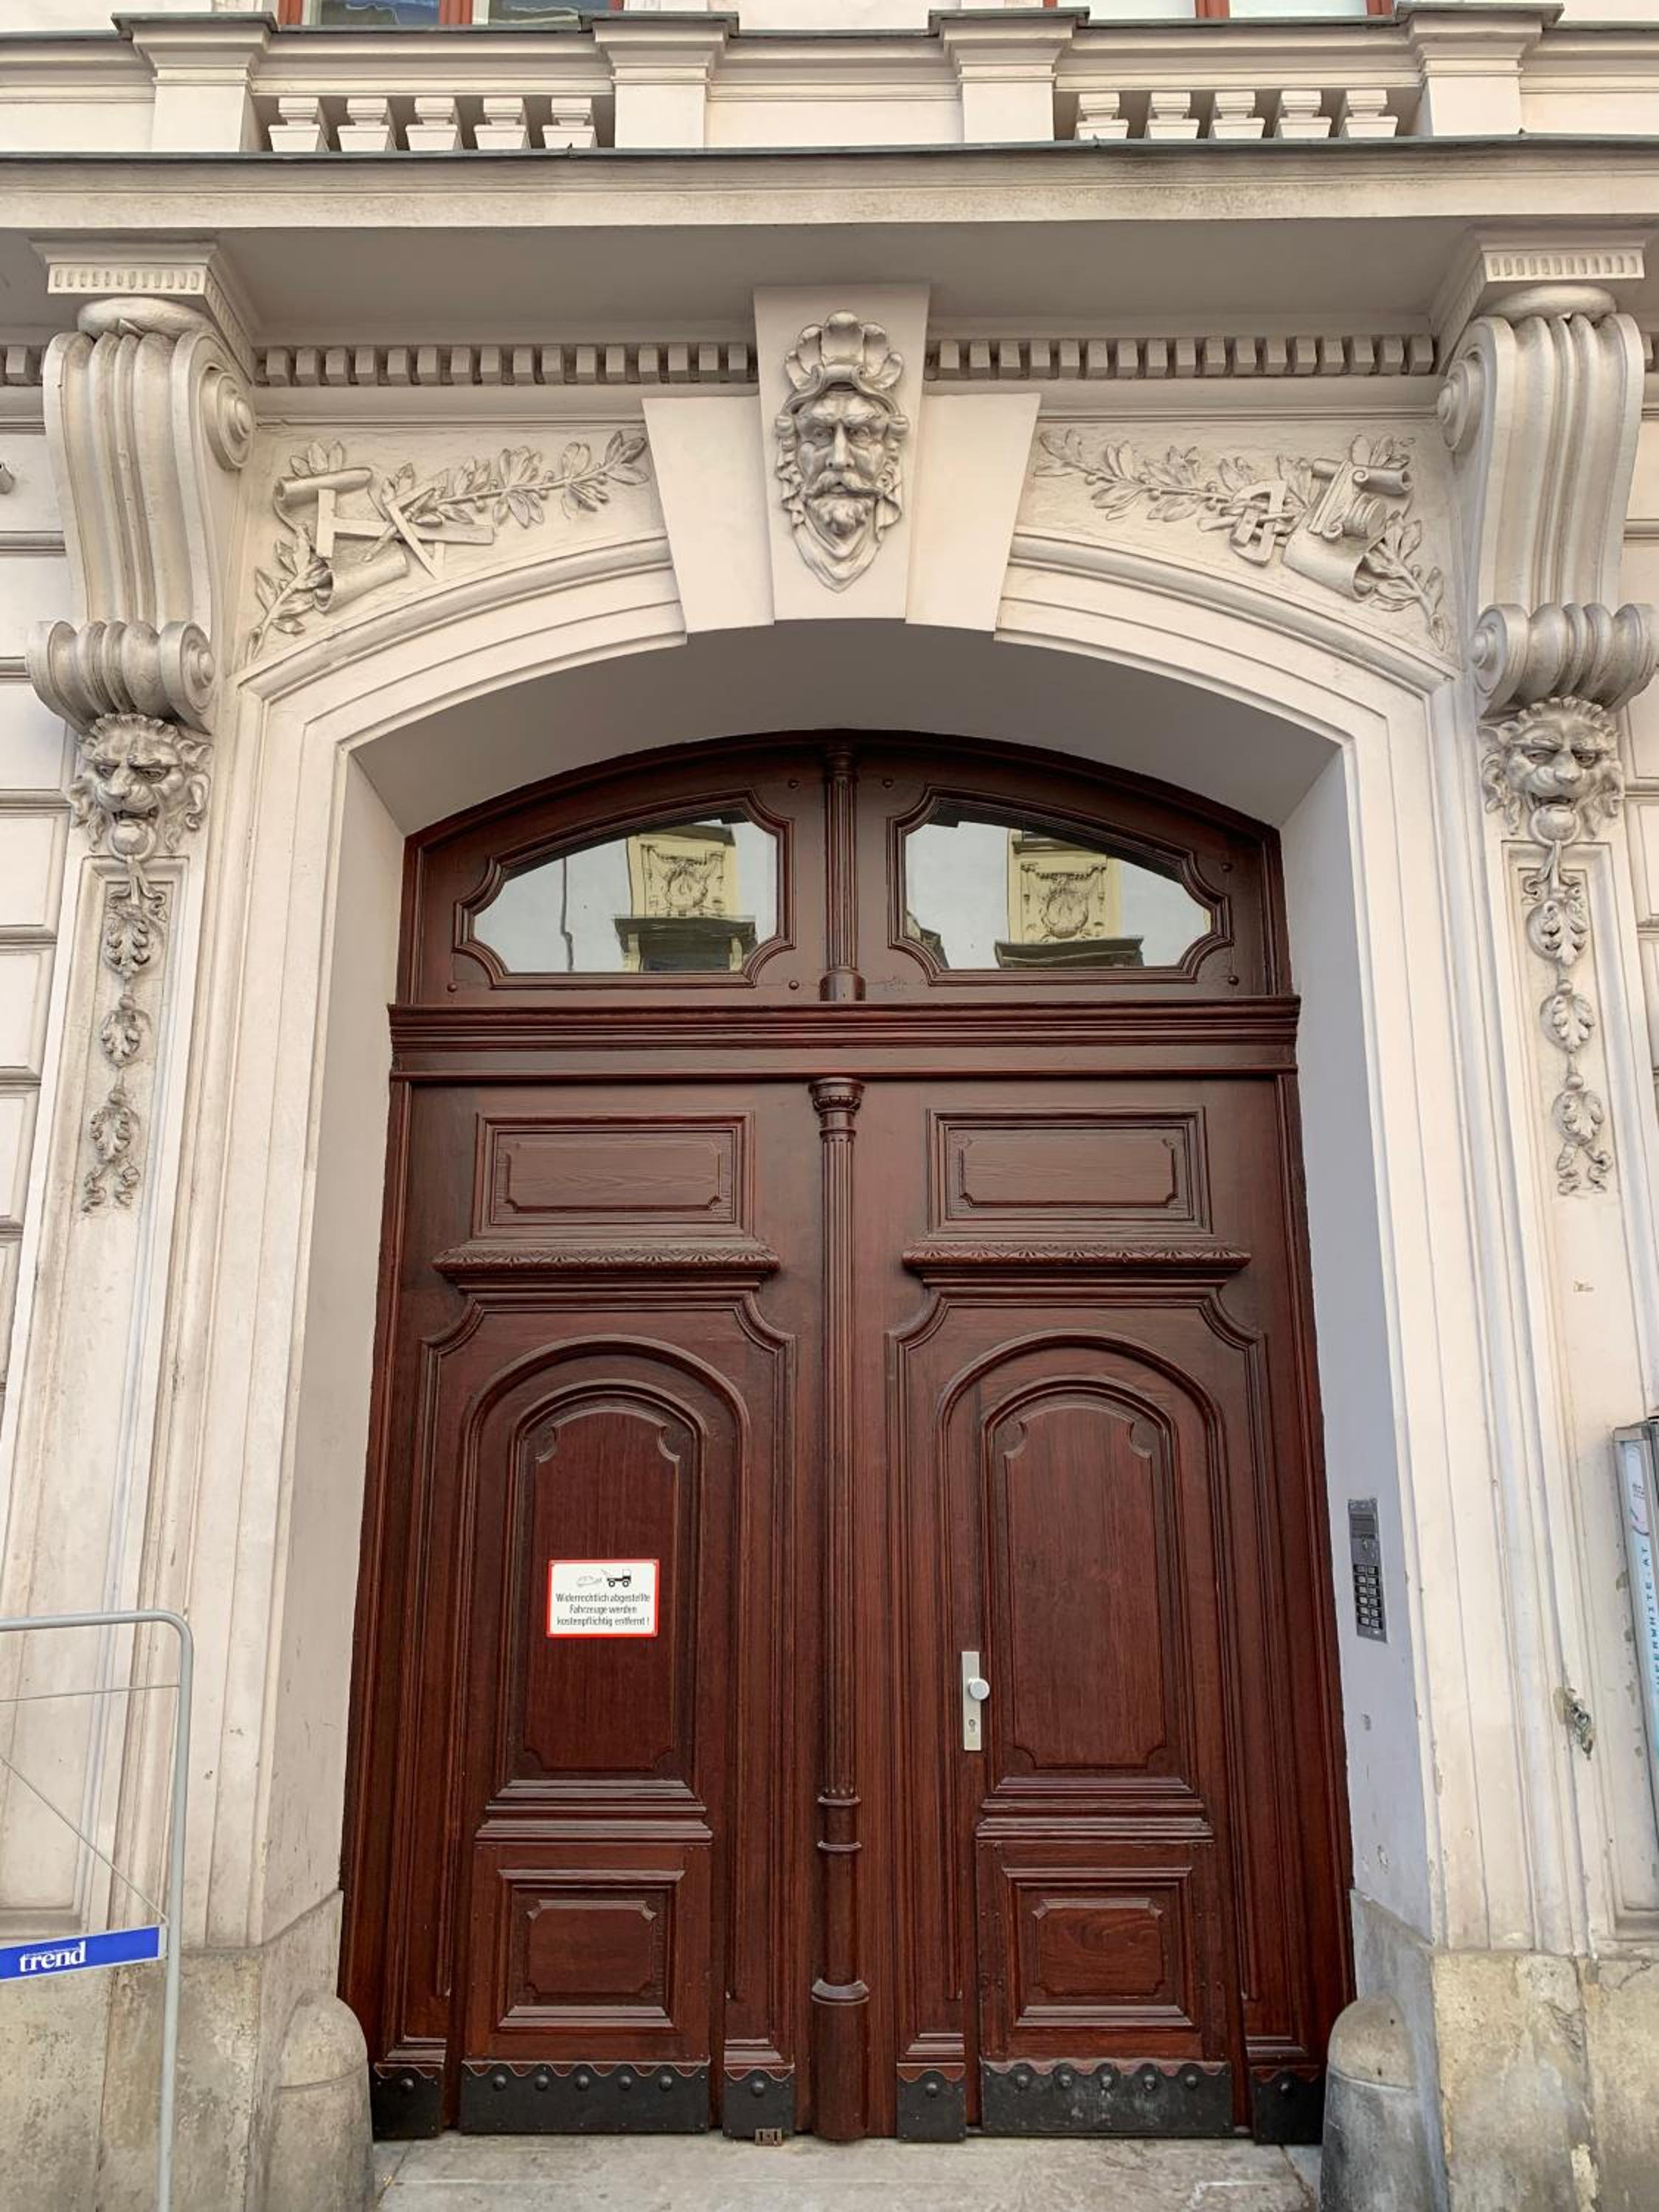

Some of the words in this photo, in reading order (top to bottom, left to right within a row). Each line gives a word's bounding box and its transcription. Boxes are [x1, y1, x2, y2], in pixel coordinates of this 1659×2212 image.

[556, 1593, 610, 1602] Widerrechtlich
[611, 1593, 650, 1603] abgestellte
[569, 1604, 608, 1615] Fahrzeuge
[608, 1605, 637, 1614] werden
[557, 1616, 613, 1627] kostenpflichtig
[1641, 1545, 1659, 1693] PERWHITE.AT
[19, 1940, 86, 1972] trend
